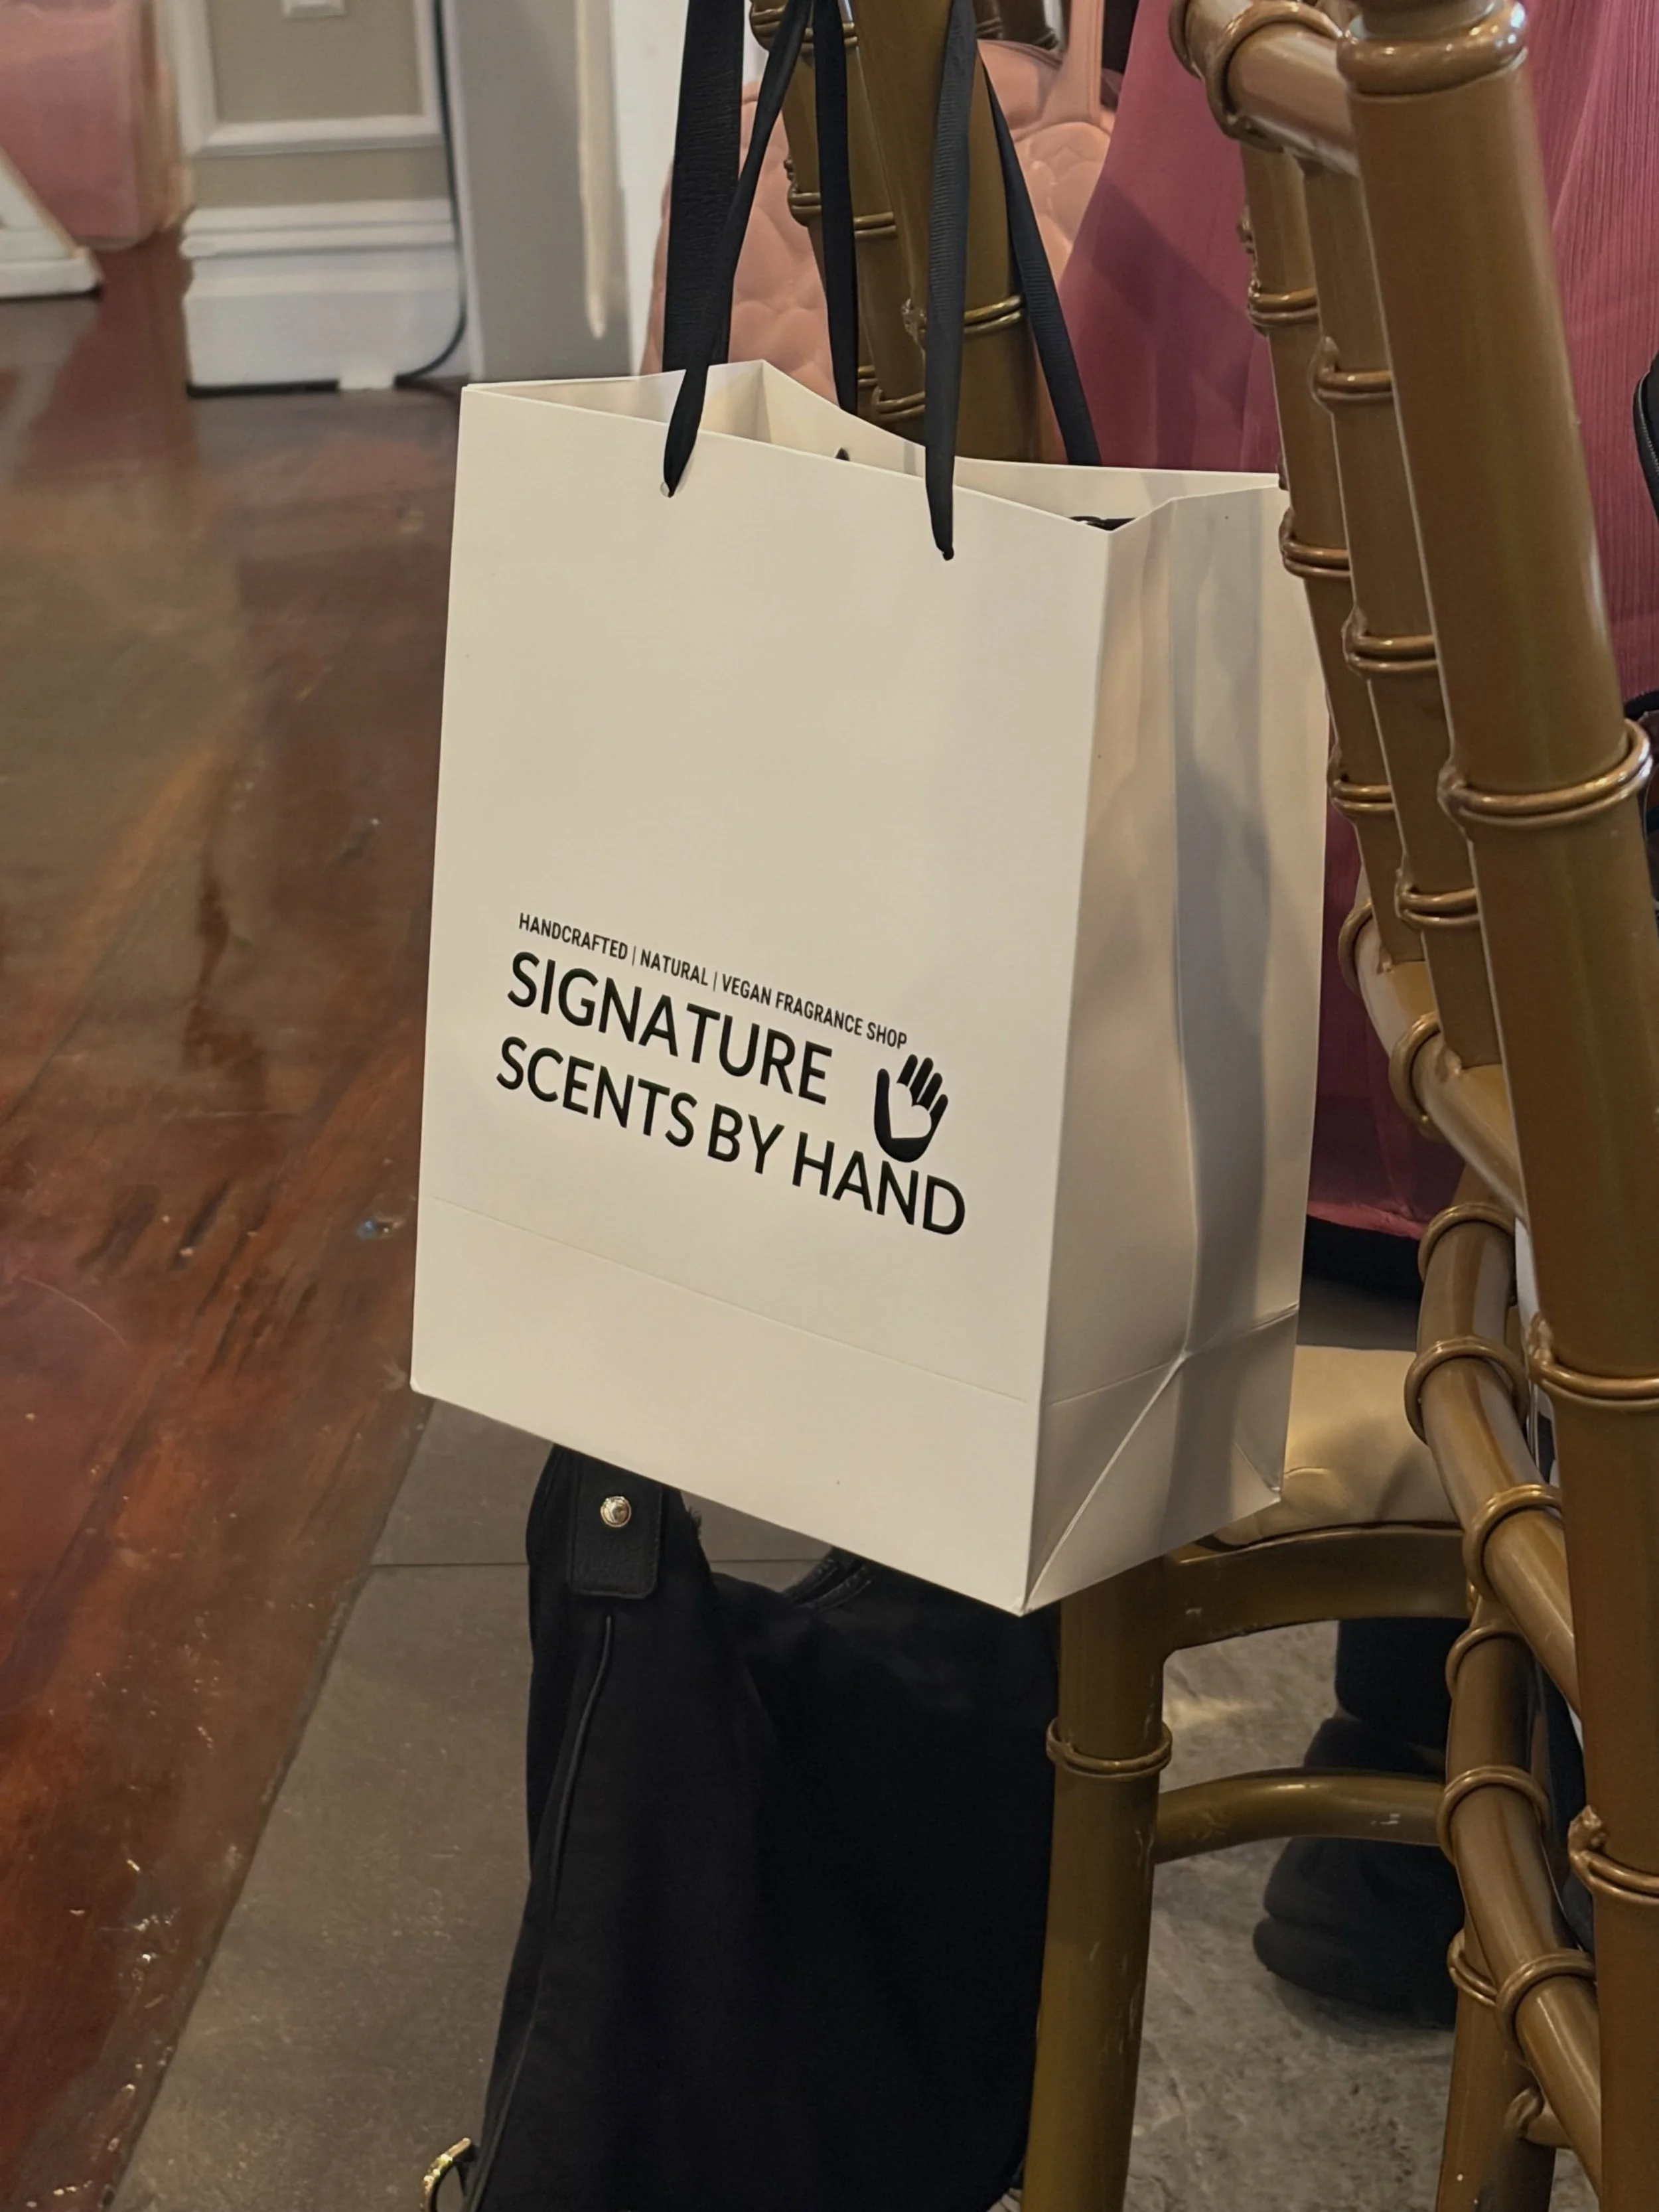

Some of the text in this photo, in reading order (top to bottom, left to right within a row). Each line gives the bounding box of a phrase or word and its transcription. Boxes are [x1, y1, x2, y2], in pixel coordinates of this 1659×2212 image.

[508, 952, 833, 1105] SIGNATURE
[520, 913, 628, 960] HANDCRAFTED
[640, 950, 708, 986] NATURAL
[723, 974, 772, 1006] VEGAN
[776, 992, 863, 1036] FRAGRANCE
[866, 1022, 908, 1051] SHOP
[496, 1036, 966, 1236] SCENTS BY HAND
